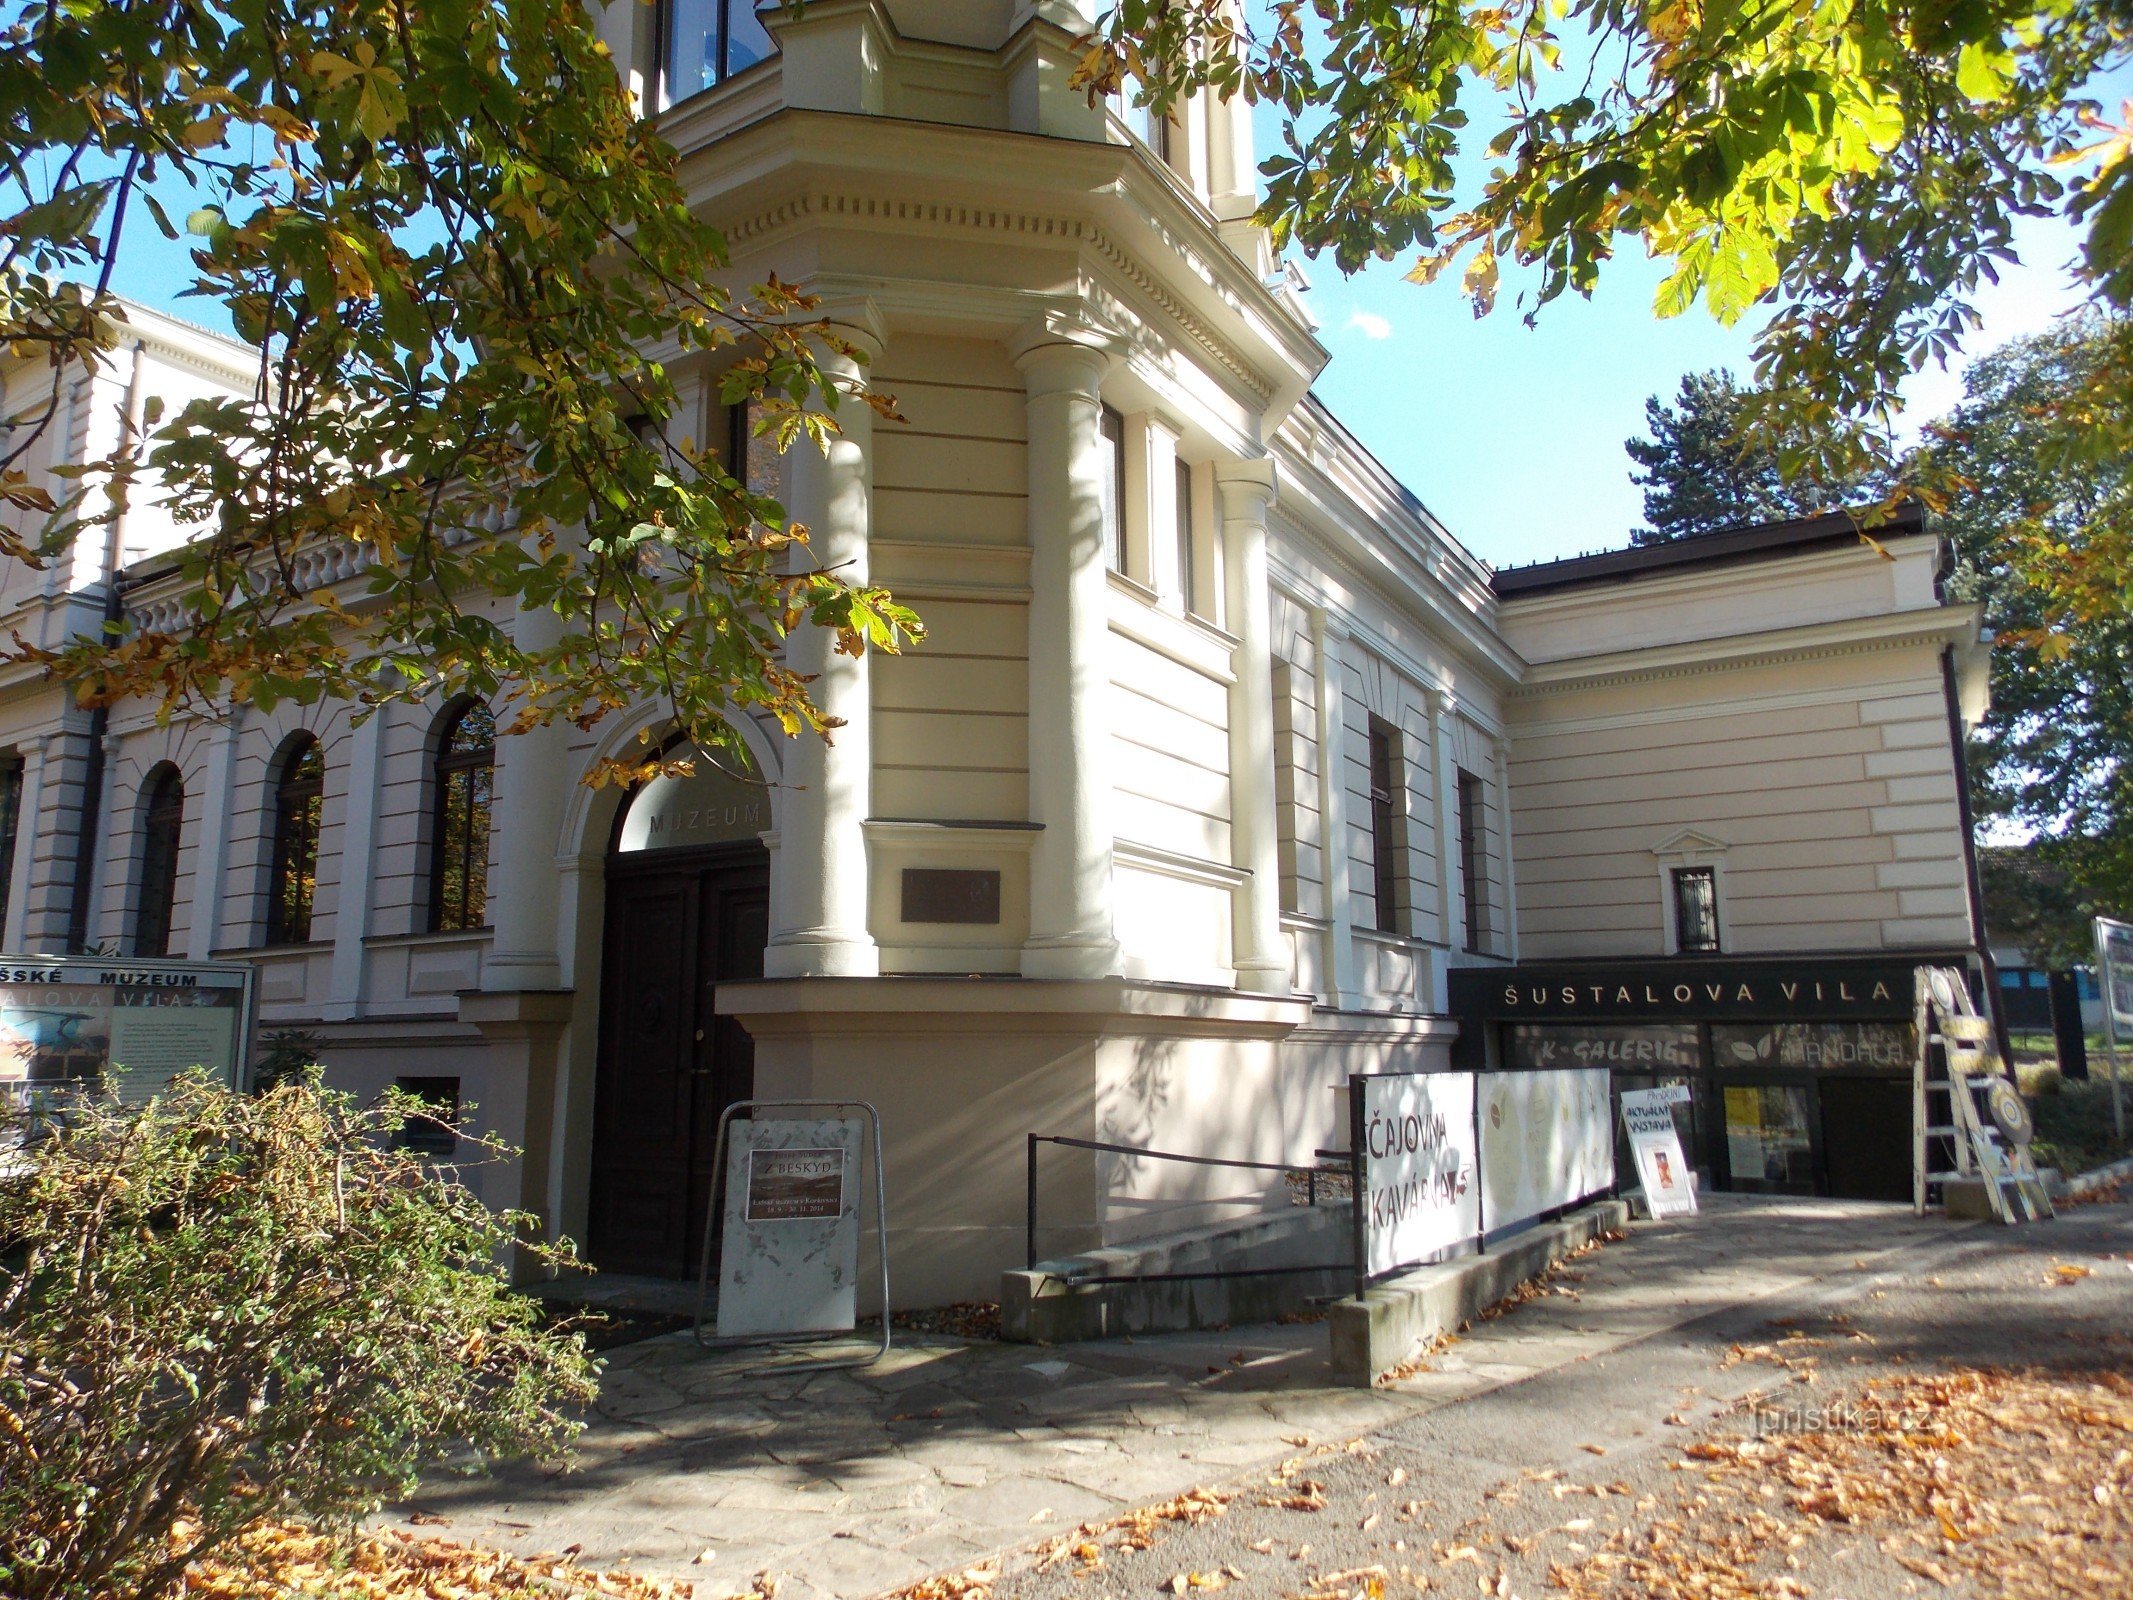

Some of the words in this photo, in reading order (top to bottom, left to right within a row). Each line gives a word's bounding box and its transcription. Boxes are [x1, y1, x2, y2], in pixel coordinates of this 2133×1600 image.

[649, 803, 760, 833] MUZEUM
[100, 972, 198, 987] MUZEUM
[1505, 983, 1753, 1006] ŠUSTALOVA
[1780, 982, 1890, 1001] VILA
[1573, 1039, 1680, 1061] GALERIE
[1368, 1109, 1449, 1160] ČAJOVNA
[778, 1162, 831, 1174] BESKYD
[1371, 1172, 1451, 1231] KAVÁRNA
